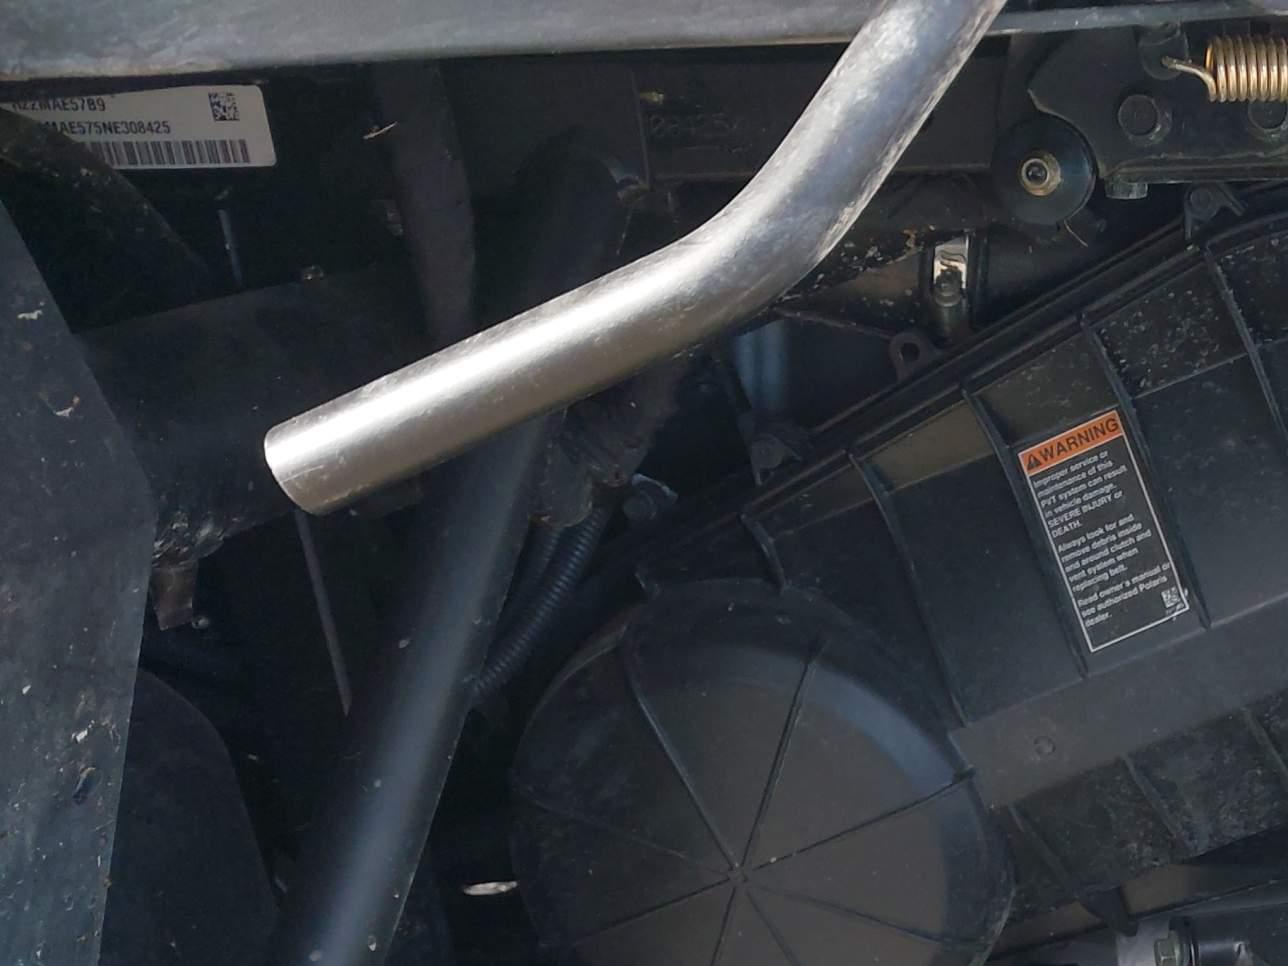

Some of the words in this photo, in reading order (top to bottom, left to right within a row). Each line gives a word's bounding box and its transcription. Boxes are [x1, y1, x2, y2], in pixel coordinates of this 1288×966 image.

[1038, 416, 1119, 462] WARNING
[1033, 467, 1069, 489] Improper
[1069, 454, 1099, 472] service
[1098, 450, 1108, 459] or
[1036, 471, 1087, 498] maintenance
[1086, 466, 1096, 475] of
[1096, 459, 1113, 472] this
[1040, 495, 1057, 507] PVT
[1057, 482, 1088, 502] system
[1087, 476, 1103, 487] can
[1102, 464, 1127, 480] result
[1044, 509, 1053, 518] in
[1053, 496, 1082, 513] vehicle
[1047, 507, 1081, 527] SEVERE
[1081, 493, 1113, 512] INJURY
[1113, 490, 1123, 499] or
[1057, 534, 1087, 554] Always
[1085, 526, 1104, 539] look
[1104, 520, 1117, 531] for
[1116, 513, 1134, 525] and
[1060, 545, 1090, 563] remove
[1090, 533, 1116, 549] debris
[1116, 521, 1142, 538] inside
[1064, 560, 1080, 572] and
[1080, 547, 1109, 565] around
[1109, 536, 1135, 552] clutch
[1135, 529, 1151, 541] and
[1068, 569, 1086, 582] vent
[1086, 557, 1116, 576] system
[1115, 546, 1138, 561] when
[1071, 571, 1109, 594] replacing
[1077, 592, 1099, 607] Read
[1098, 578, 1131, 598] owner's
[1130, 565, 1161, 584] manual
[1161, 562, 1170, 570] or
[1081, 606, 1096, 617] see
[1095, 587, 1138, 611] authorized
[1138, 573, 1167, 592] Polaris
